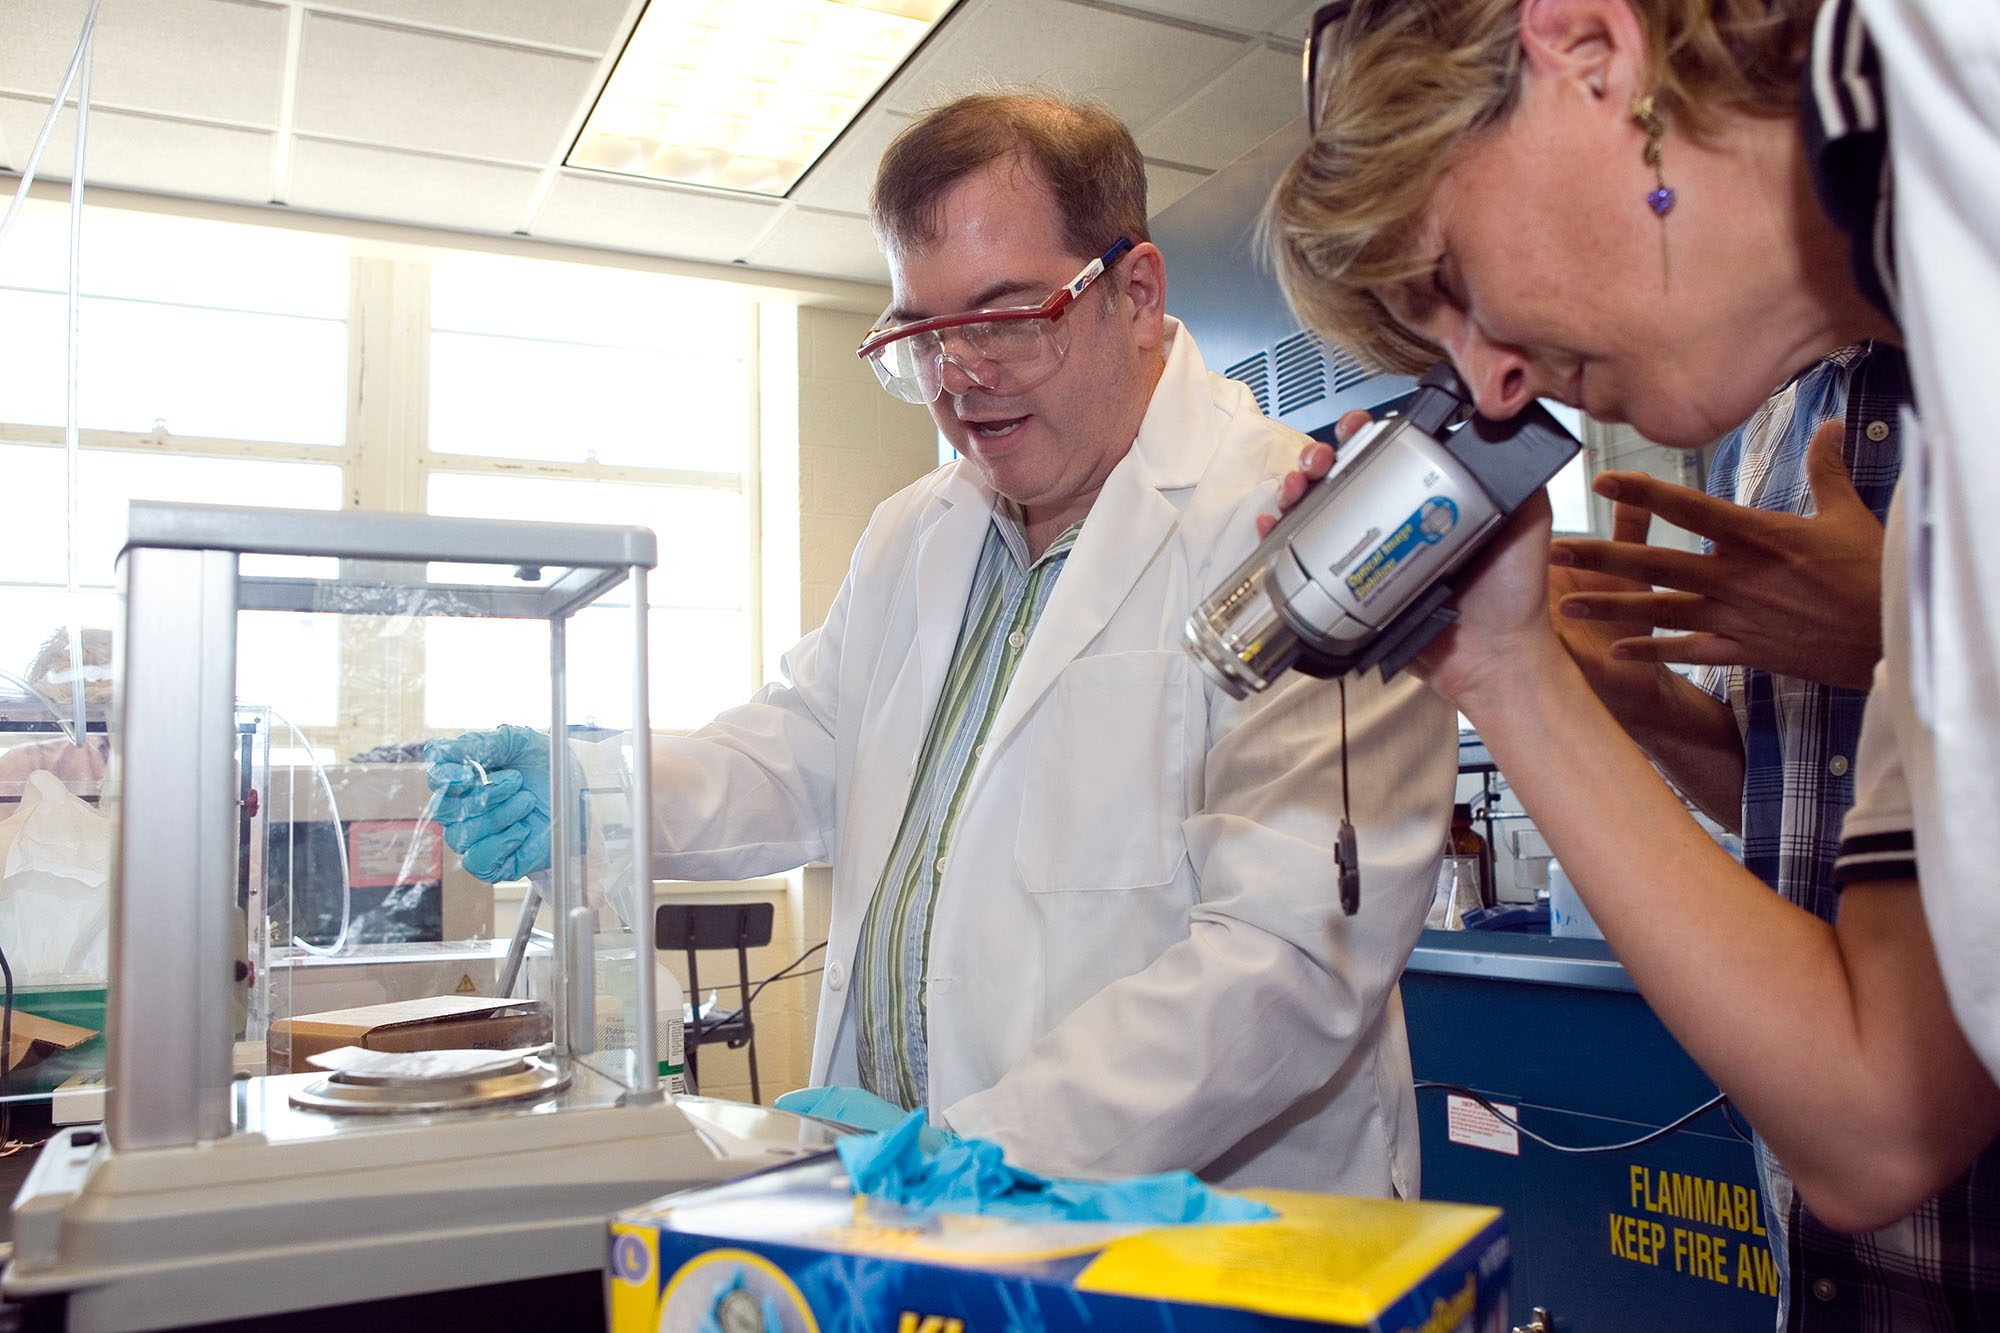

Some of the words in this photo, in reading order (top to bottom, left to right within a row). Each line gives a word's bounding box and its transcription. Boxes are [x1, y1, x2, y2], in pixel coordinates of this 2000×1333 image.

[1630, 1165, 1767, 1237] FLAMMABL
[1609, 1213, 1666, 1266] KEEP
[1673, 1227, 1729, 1284] FIRE
[1737, 1243, 1779, 1297] AW
